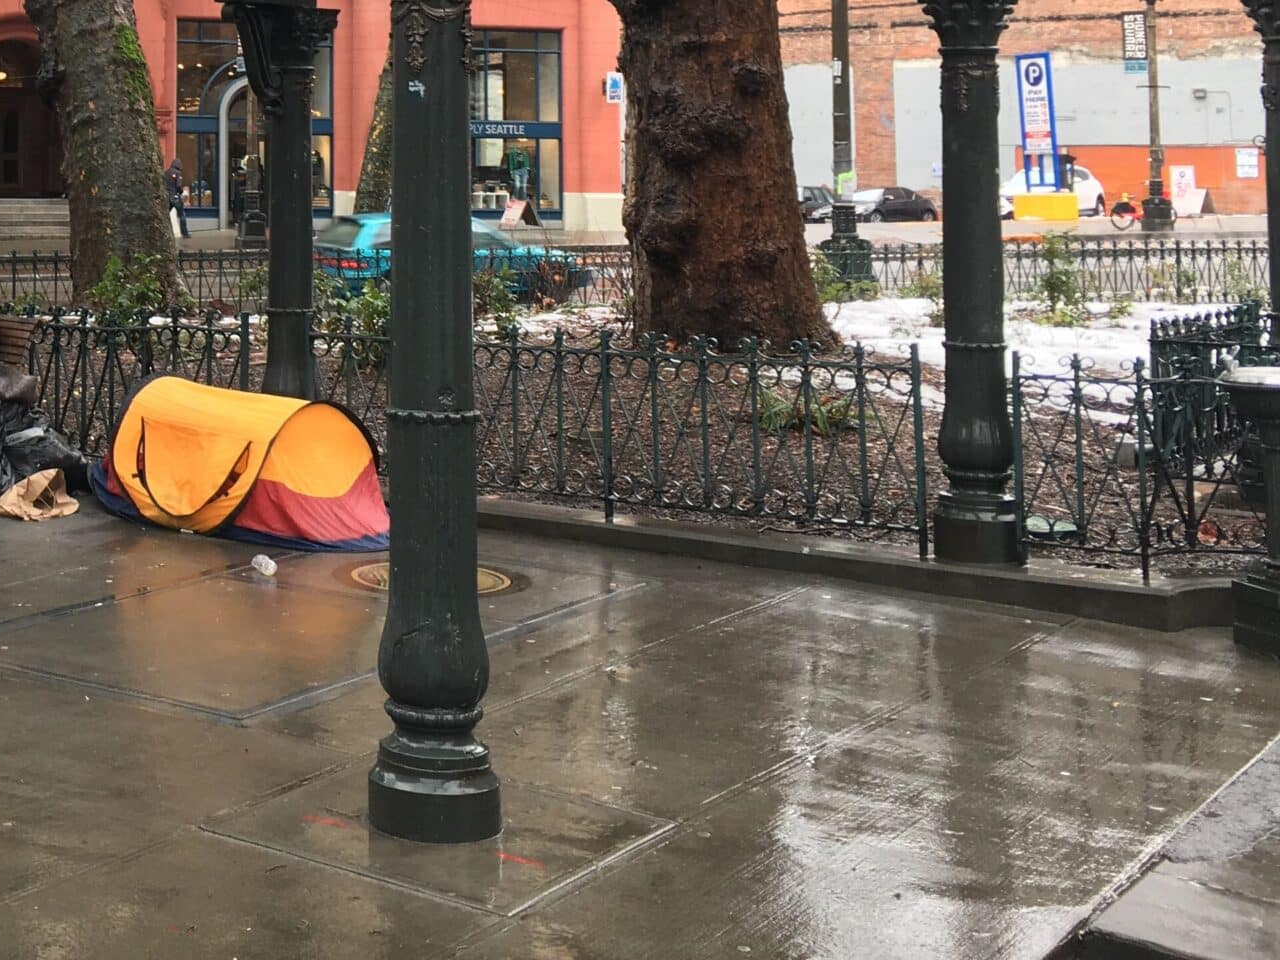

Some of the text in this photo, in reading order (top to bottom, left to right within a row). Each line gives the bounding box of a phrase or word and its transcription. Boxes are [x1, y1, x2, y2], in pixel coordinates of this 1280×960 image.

[1124, 15, 1135, 58] SQUARE
[1135, 14, 1145, 58] PIONEER
[485, 124, 526, 135] SEATTLE
